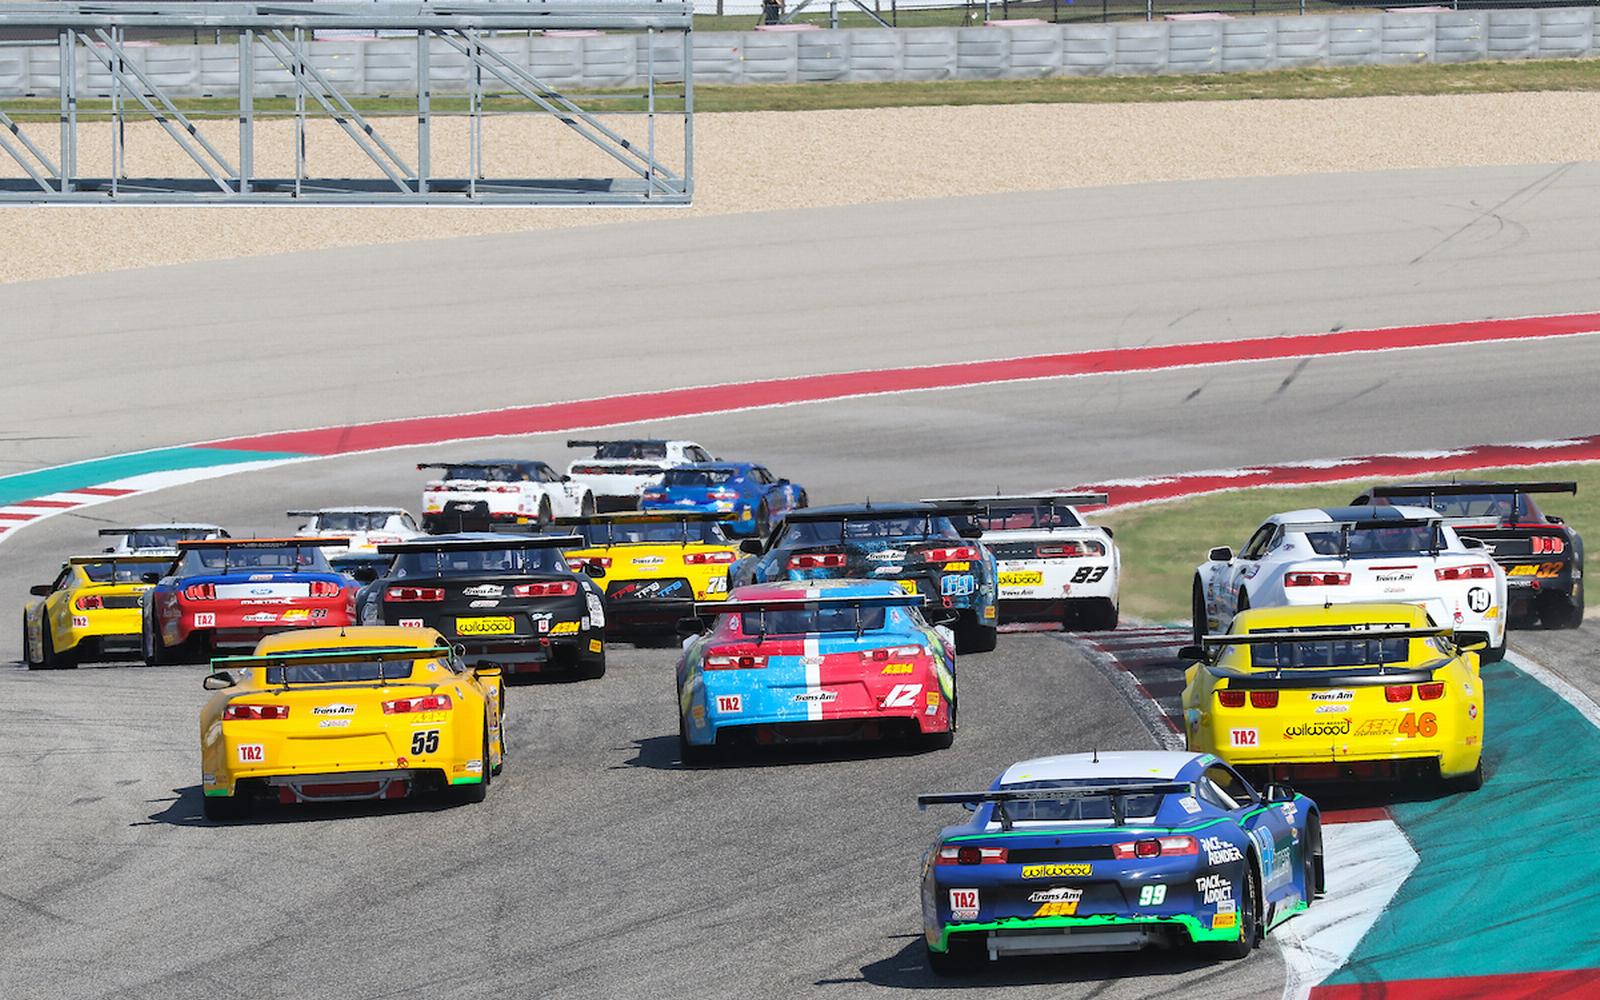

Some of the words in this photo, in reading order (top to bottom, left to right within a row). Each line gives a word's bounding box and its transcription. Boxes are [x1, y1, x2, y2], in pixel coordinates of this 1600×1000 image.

[1070, 566, 1108, 583] 83
[1536, 562, 1564, 578] 32
[1468, 589, 1490, 611] 19
[197, 615, 214, 625] TA2
[460, 621, 512, 632] wilwood
[719, 697, 740, 711] TA2
[1286, 720, 1349, 736] wilwood
[1398, 712, 1438, 738] 46
[411, 730, 440, 755] 55
[1232, 731, 1256, 744] TA2
[241, 747, 262, 760] TA2
[1023, 866, 1092, 877] wilwood
[952, 892, 976, 908] TA2
[1033, 892, 1058, 901] Trans
[1061, 891, 1080, 900] Am
[1139, 884, 1167, 906] 99
[1203, 886, 1232, 904] ADDICT
